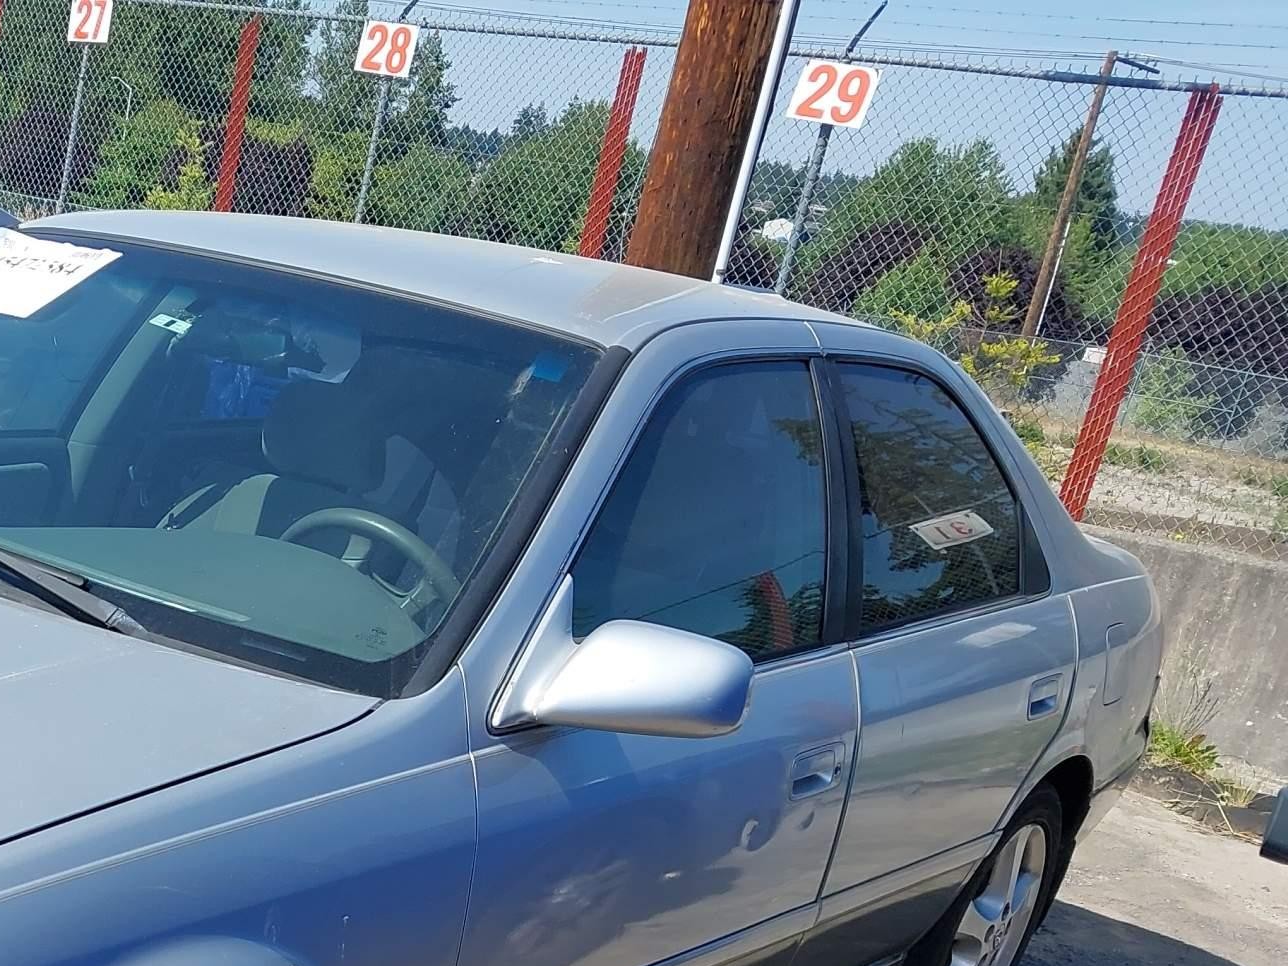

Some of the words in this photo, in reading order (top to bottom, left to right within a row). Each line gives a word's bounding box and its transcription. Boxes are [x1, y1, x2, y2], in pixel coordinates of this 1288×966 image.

[74, 0, 107, 40] 27
[361, 24, 412, 75] 28
[795, 63, 870, 124] 29
